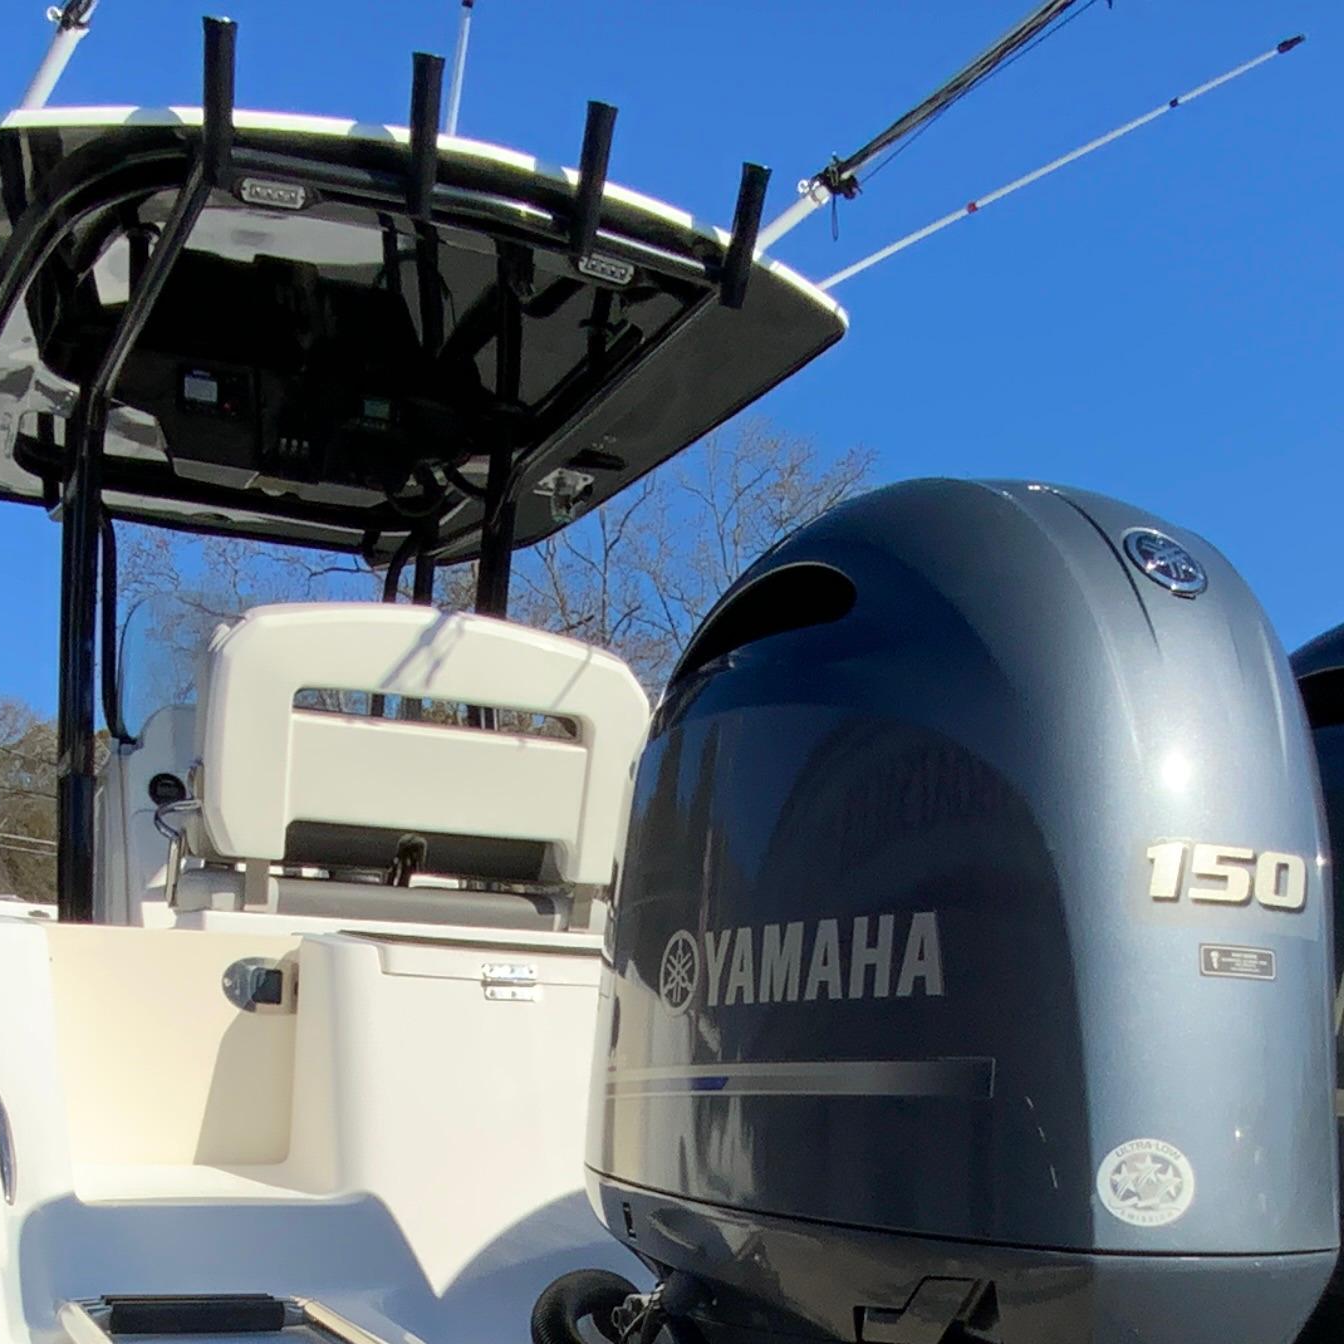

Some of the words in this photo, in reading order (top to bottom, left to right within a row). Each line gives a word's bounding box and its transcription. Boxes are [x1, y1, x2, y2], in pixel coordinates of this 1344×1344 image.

[1146, 840, 1307, 914] 150
[705, 911, 945, 1007] YAMAHA
[1115, 1141, 1153, 1158] ULTRA
